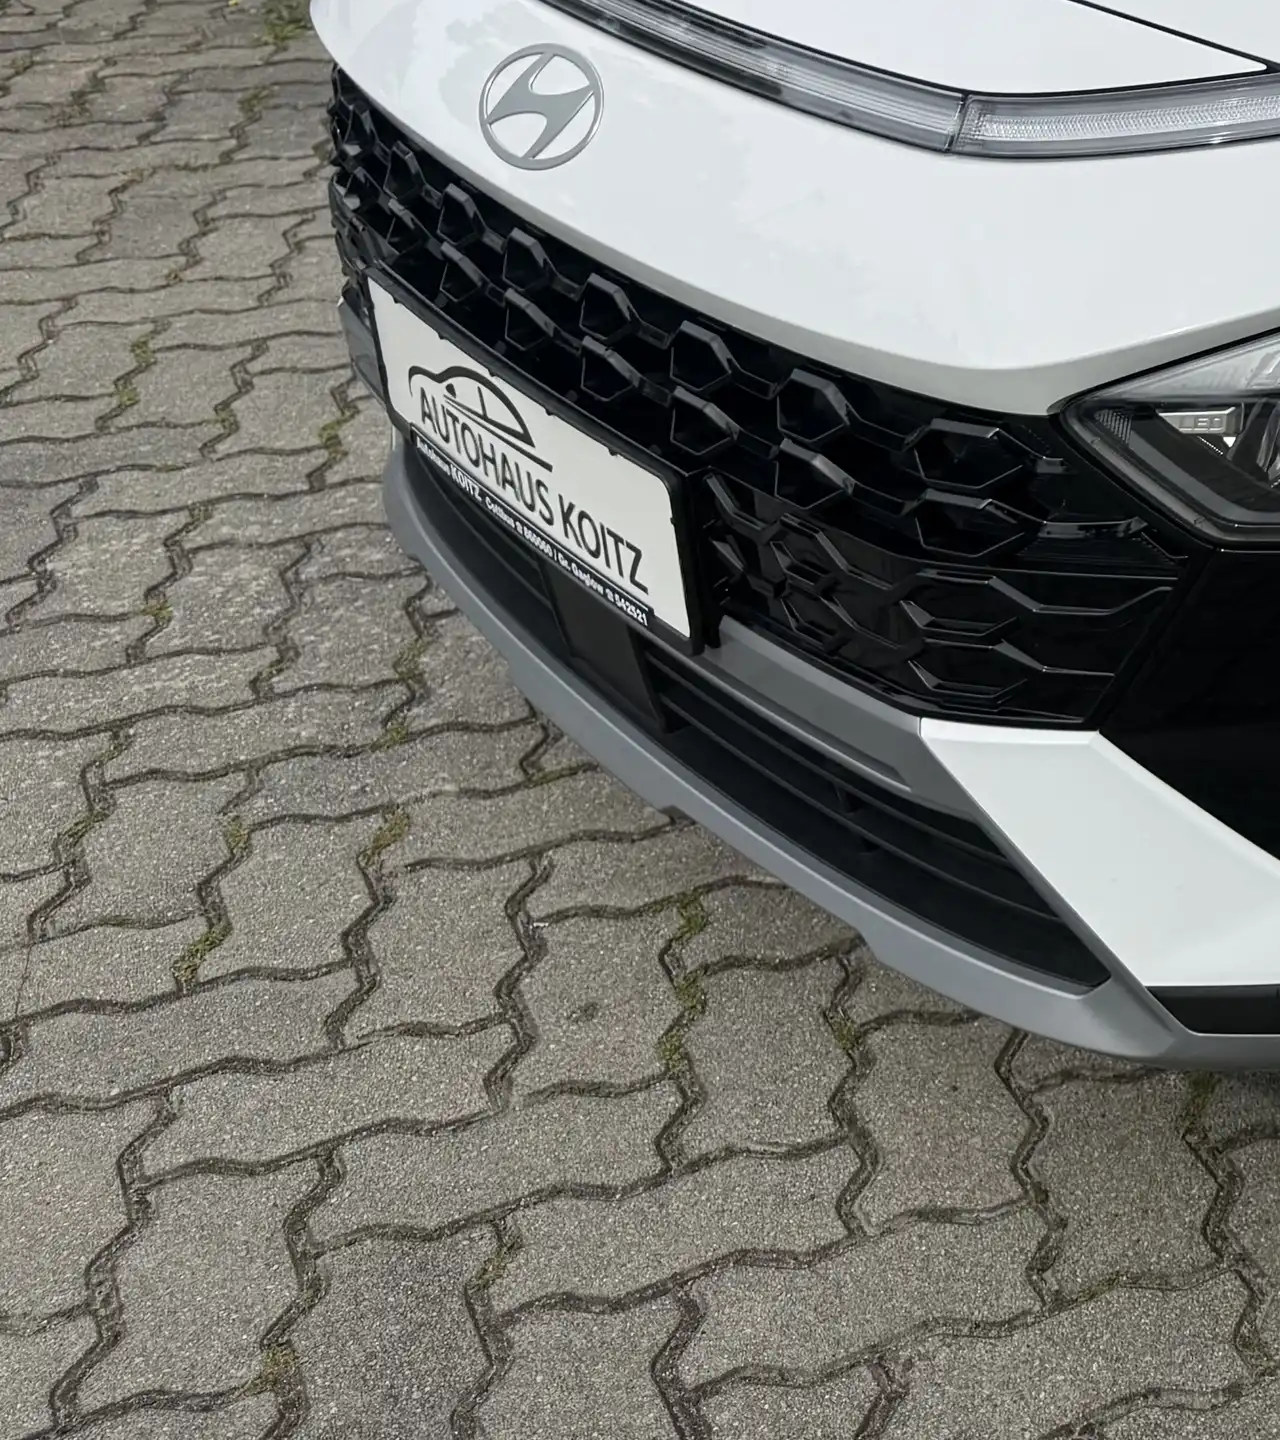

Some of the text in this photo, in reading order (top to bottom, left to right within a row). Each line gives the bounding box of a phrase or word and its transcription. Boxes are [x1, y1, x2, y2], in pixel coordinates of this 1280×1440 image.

[1178, 417, 1223, 431] LED
[420, 386, 649, 596] AUTOHAUS KOITZ
[450, 463, 483, 503] KOITZ
